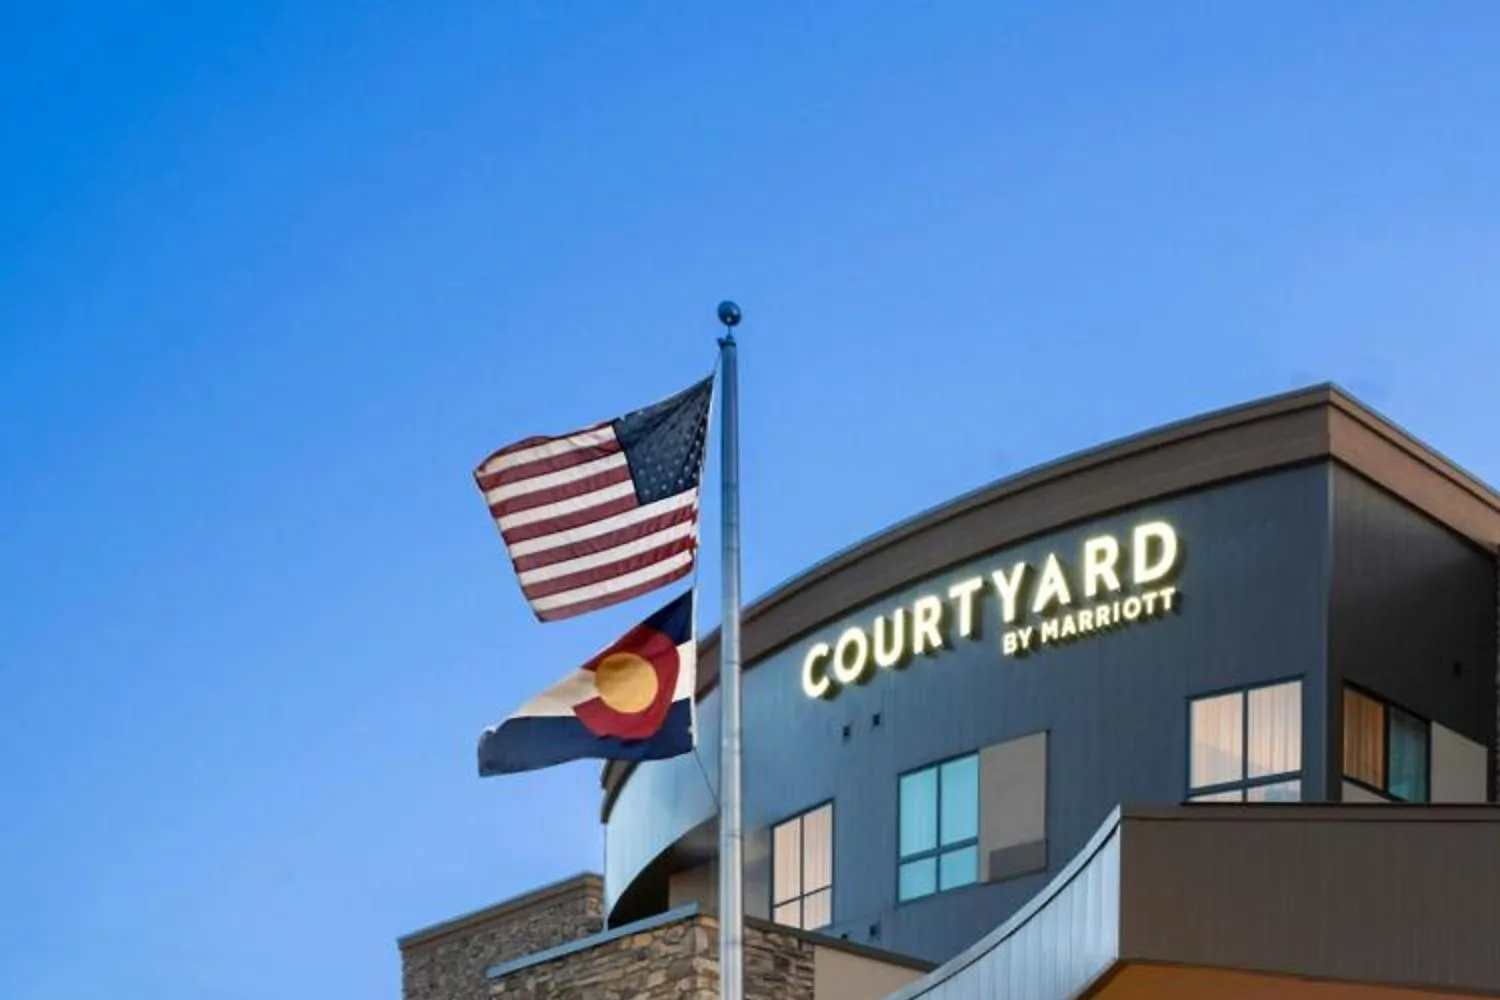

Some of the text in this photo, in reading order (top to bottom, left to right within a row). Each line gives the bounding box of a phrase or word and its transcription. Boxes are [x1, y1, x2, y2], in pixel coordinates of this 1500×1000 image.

[802, 521, 1178, 698] COURTYARD
[1003, 587, 1177, 656] BY MARRIOTT
